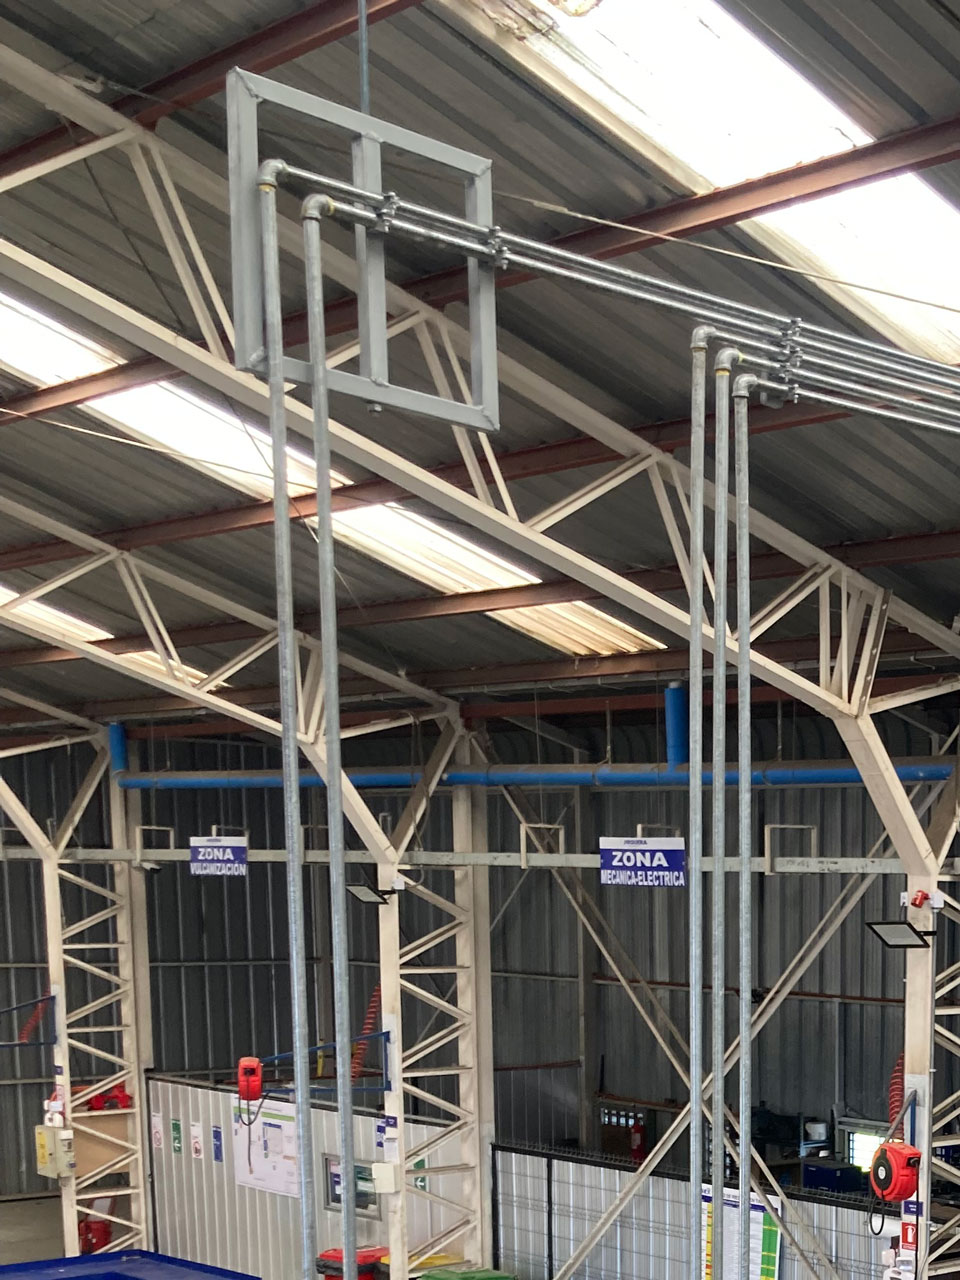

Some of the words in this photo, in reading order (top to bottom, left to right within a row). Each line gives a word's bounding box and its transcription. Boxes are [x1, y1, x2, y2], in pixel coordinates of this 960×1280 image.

[198, 848, 234, 860] ZONA
[612, 851, 669, 867] ZONA
[600, 869, 685, 886] MECANICA-ELECTRICA
